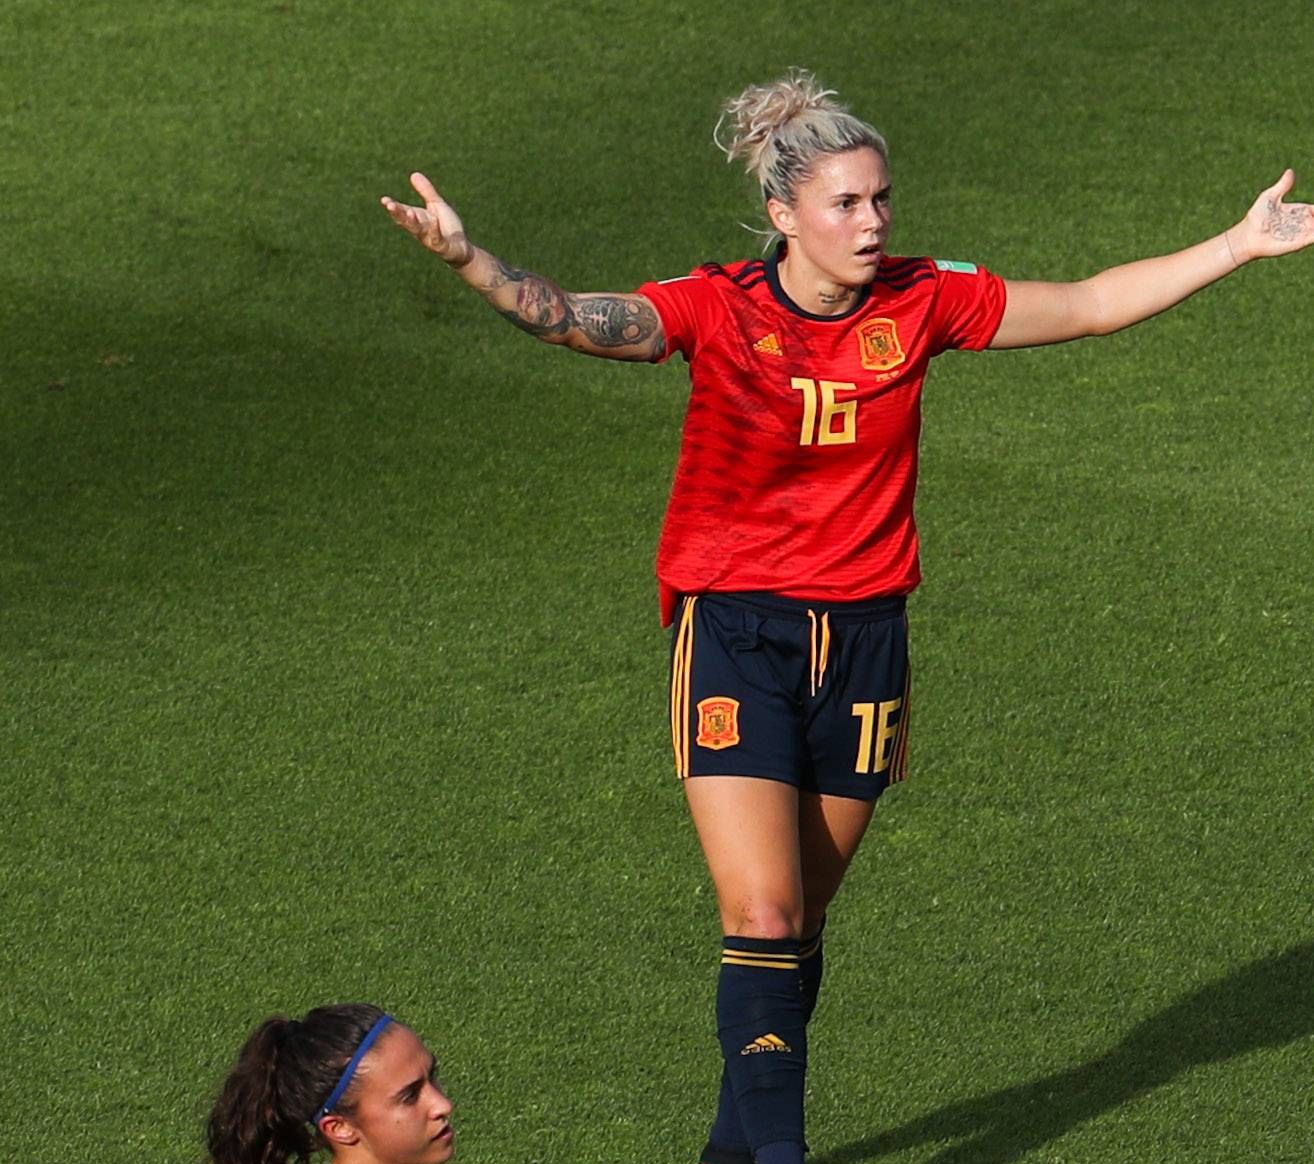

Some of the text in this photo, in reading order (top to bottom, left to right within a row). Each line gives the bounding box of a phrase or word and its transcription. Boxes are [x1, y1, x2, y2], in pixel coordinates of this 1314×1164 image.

[790, 377, 858, 446] 16
[851, 697, 902, 774] 16
[741, 1044, 791, 1056] adidas
